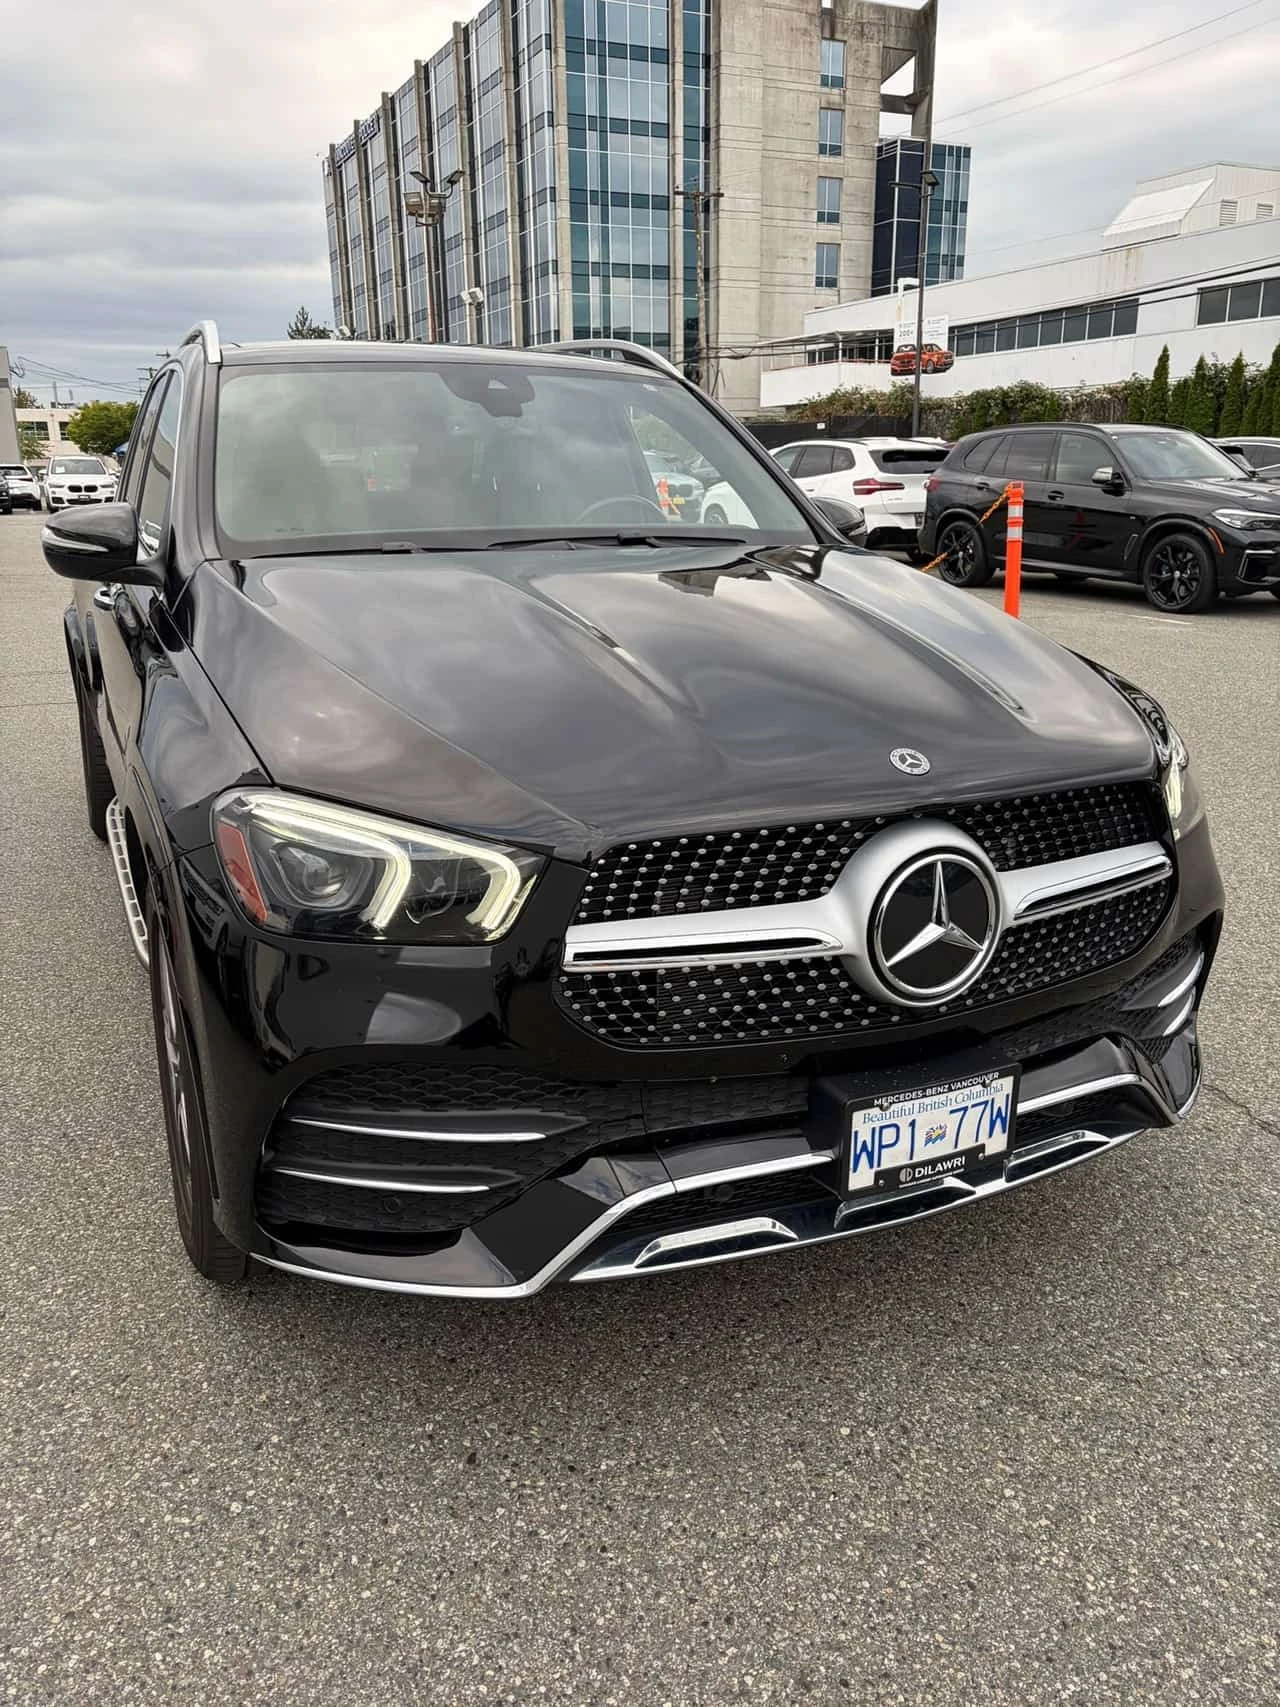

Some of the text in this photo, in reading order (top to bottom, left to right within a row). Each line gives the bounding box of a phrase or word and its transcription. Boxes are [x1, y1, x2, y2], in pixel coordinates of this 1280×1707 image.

[863, 1083, 1004, 1124] Beautiful British Columbia
[873, 1071, 1000, 1107] MERCEDES-BENZ VANCOUVER
[852, 1093, 1010, 1176] WP1 77W
[914, 1155, 965, 1178] DILAWRI
